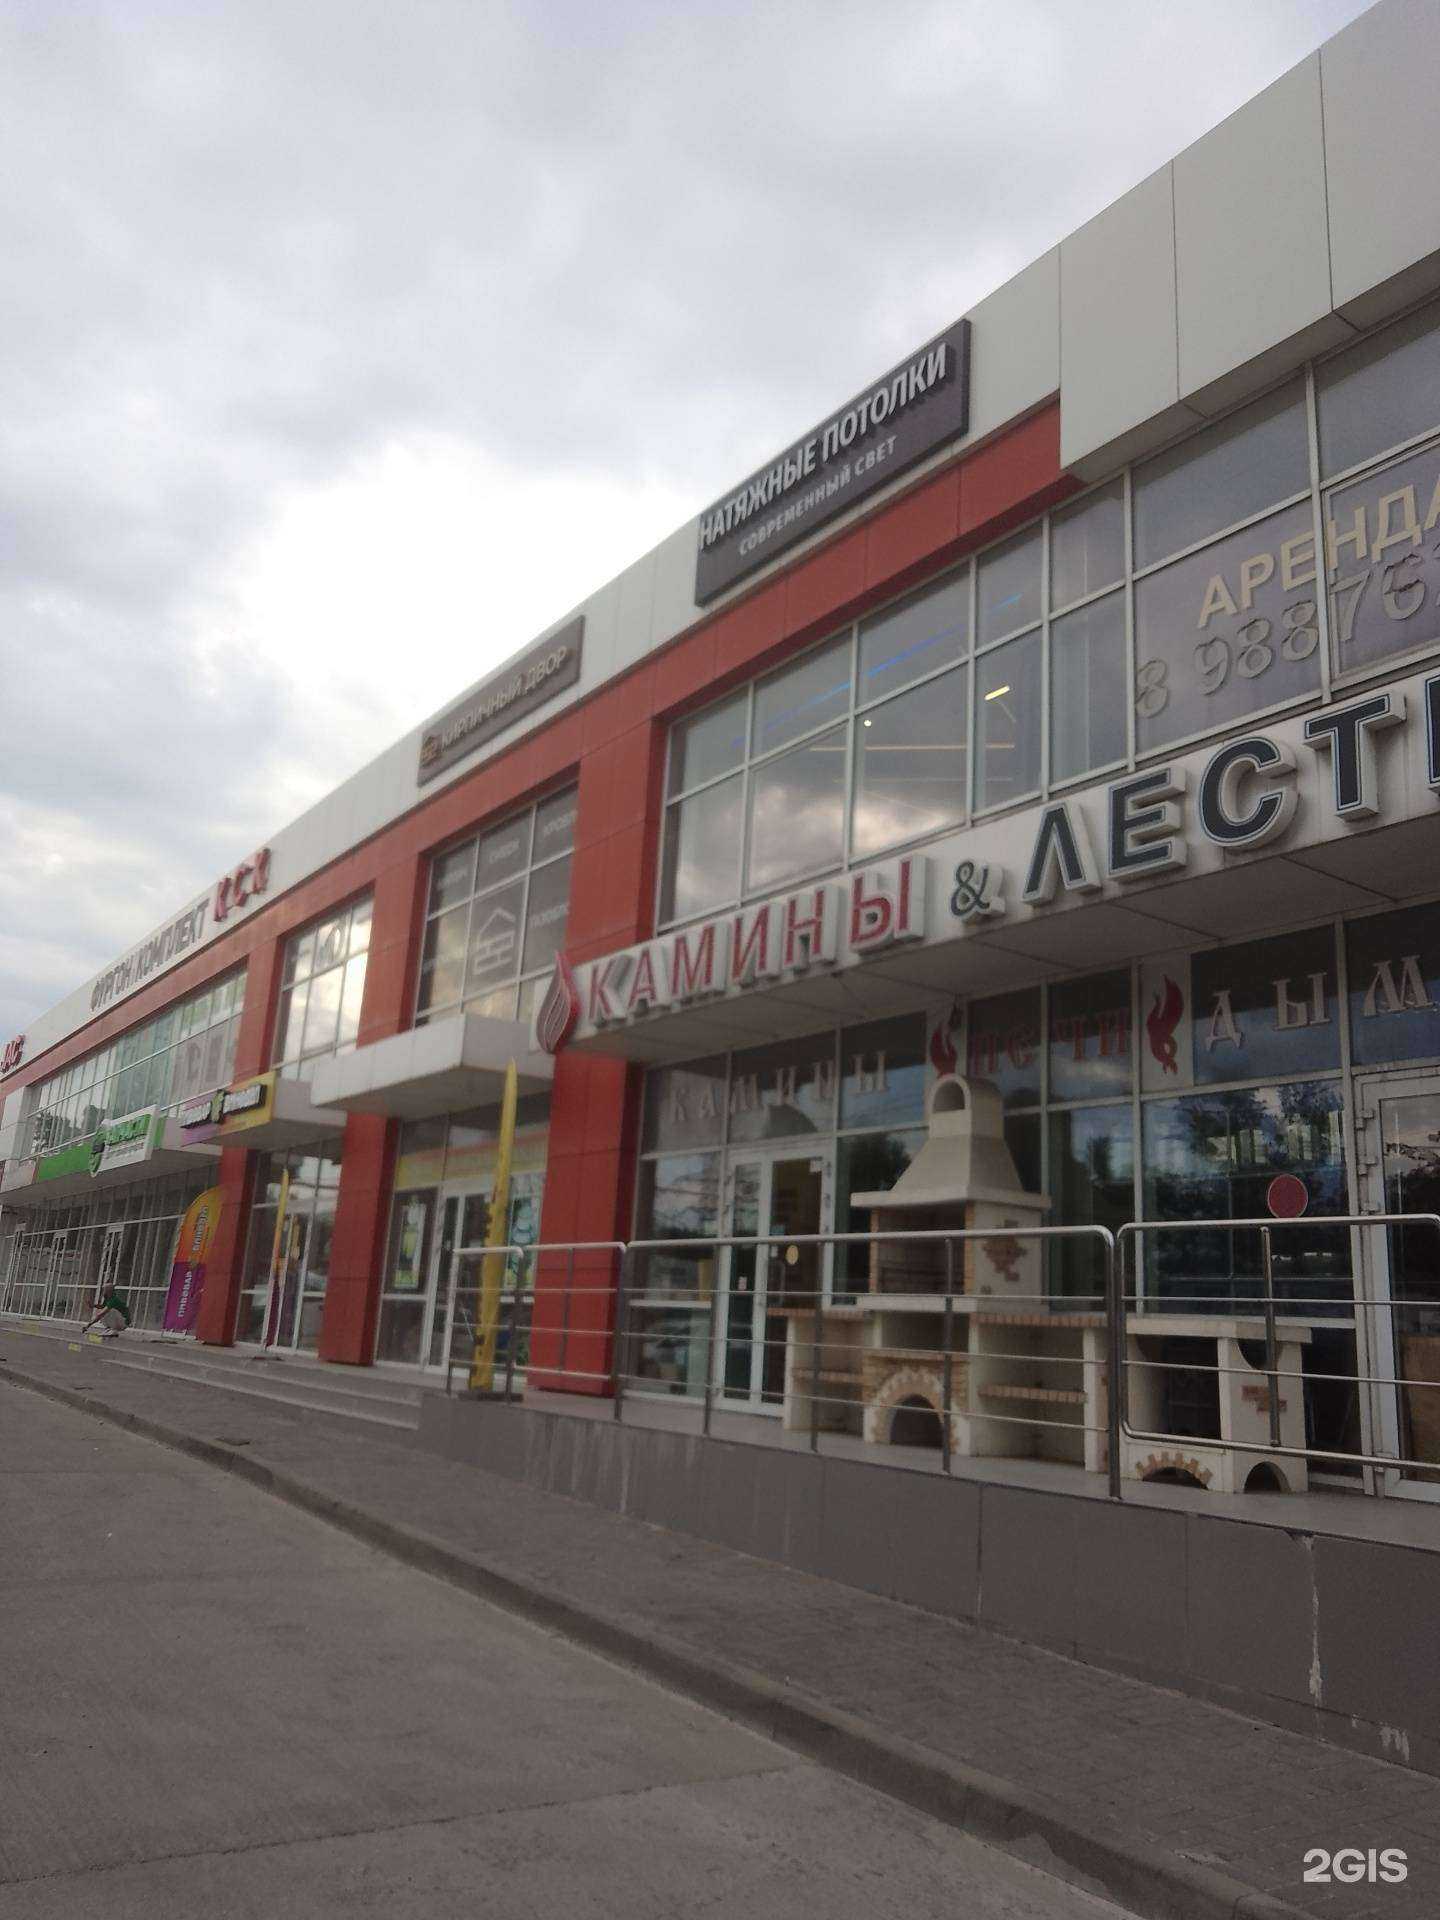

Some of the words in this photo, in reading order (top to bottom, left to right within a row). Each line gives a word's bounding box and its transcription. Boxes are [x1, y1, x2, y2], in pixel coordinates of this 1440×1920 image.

[697, 437, 817, 550] НАТЯЖНЫЕ
[821, 342, 947, 463] ПОТОЛКИ
[739, 464, 852, 556] СОВРЕМЕННЫЙ
[854, 434, 897, 476] СВЕТ
[440, 672, 523, 752] КИРПИЧНЫЙ
[525, 645, 567, 694] ДВОР
[587, 855, 915, 1023] КАМИНЫ
[948, 858, 993, 920] &
